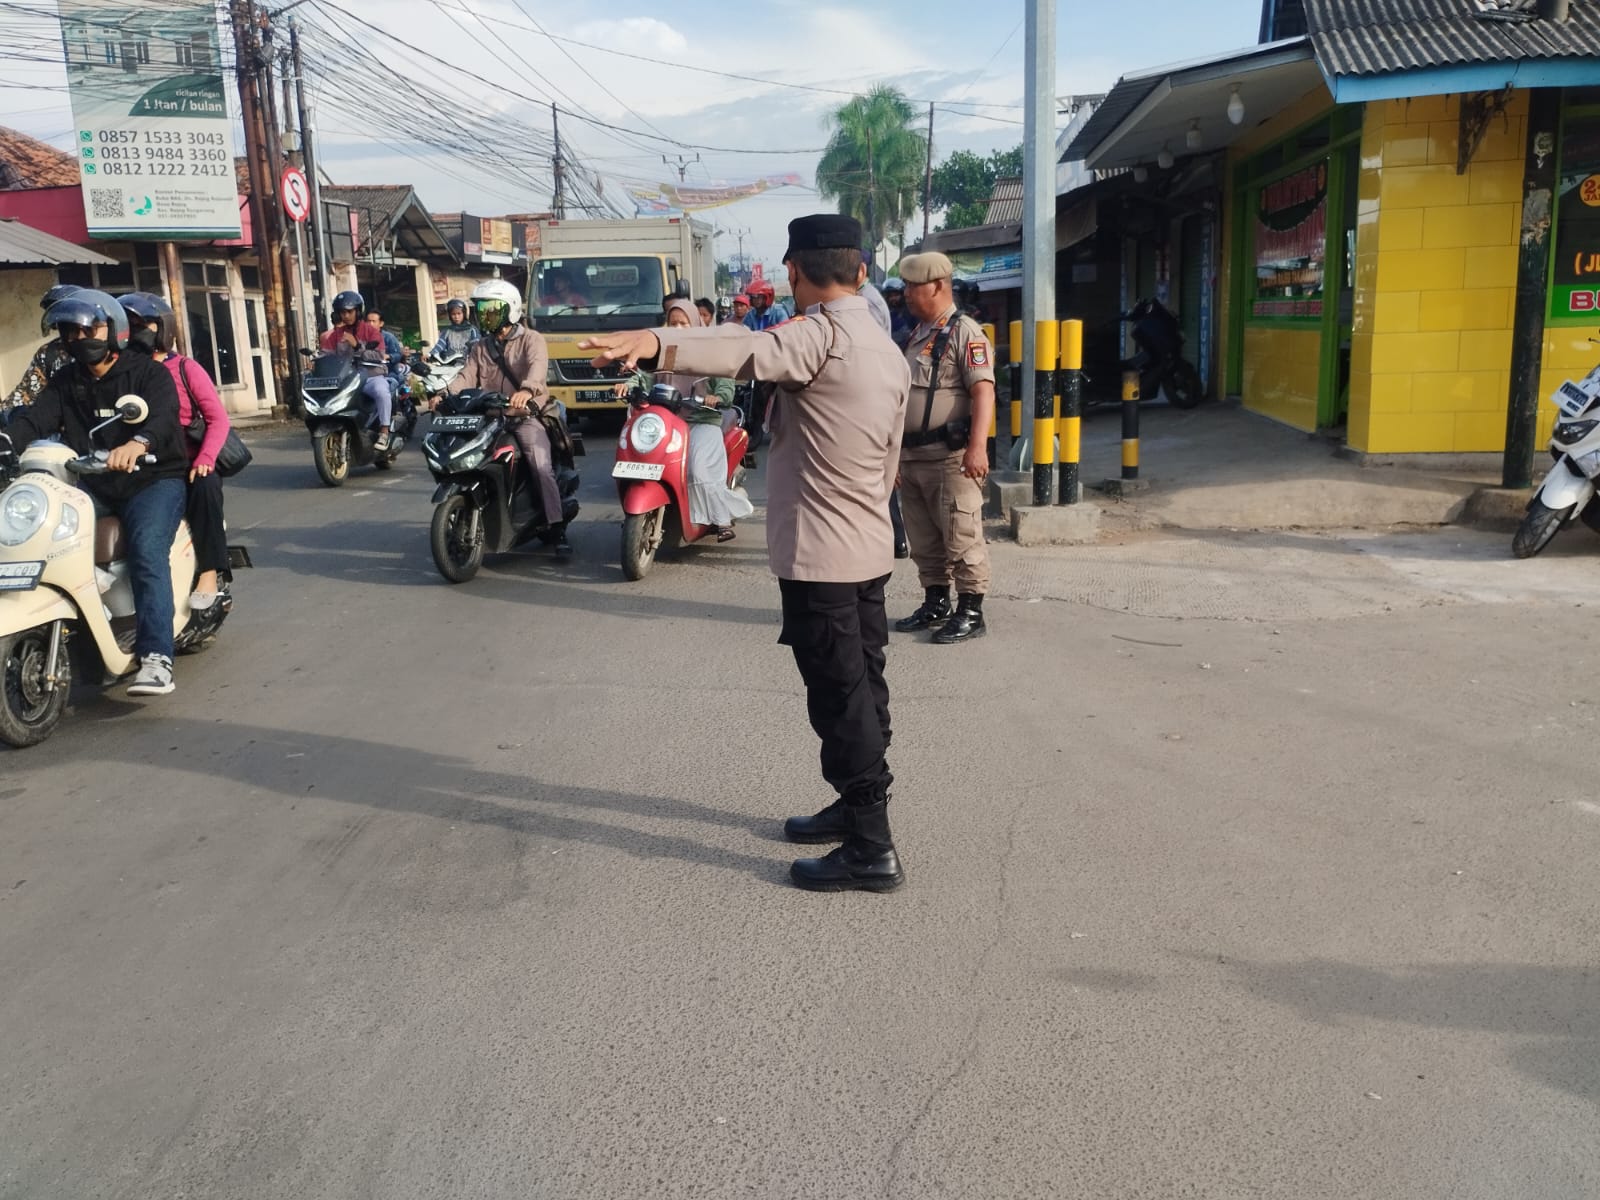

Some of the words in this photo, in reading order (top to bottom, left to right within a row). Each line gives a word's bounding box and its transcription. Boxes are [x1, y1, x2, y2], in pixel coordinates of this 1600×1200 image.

[143, 98, 151, 109] 1
[189, 99, 223, 112] bulan
[98, 130, 137, 144] 0857
[143, 131, 181, 145] 1533
[187, 132, 224, 145] 3043
[101, 146, 140, 160] 0813
[146, 147, 184, 161] 9484
[190, 148, 226, 162] 3360
[103, 162, 142, 176] 0812
[148, 163, 186, 176] 1222
[191, 164, 229, 177] 2412
[1584, 178, 1600, 194] 2
[1584, 193, 1600, 201] JA
[1569, 289, 1600, 312] B
